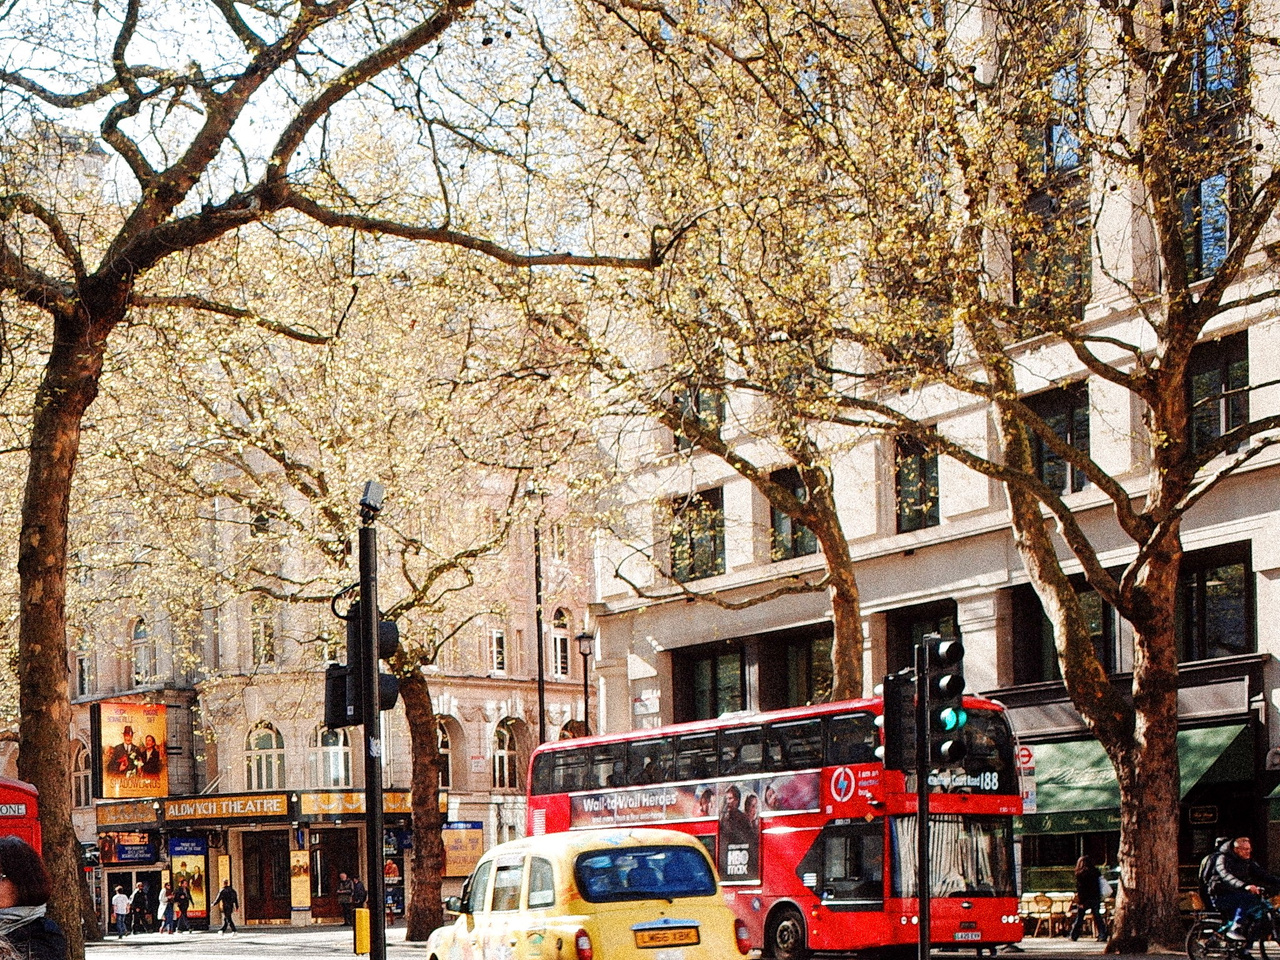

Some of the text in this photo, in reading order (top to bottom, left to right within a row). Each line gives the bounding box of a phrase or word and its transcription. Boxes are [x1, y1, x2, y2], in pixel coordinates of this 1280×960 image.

[980, 772, 999, 790] 188
[168, 799, 282, 817] ALDWYCH THEATRE
[727, 850, 749, 865] HBO
[727, 864, 748, 875] max
